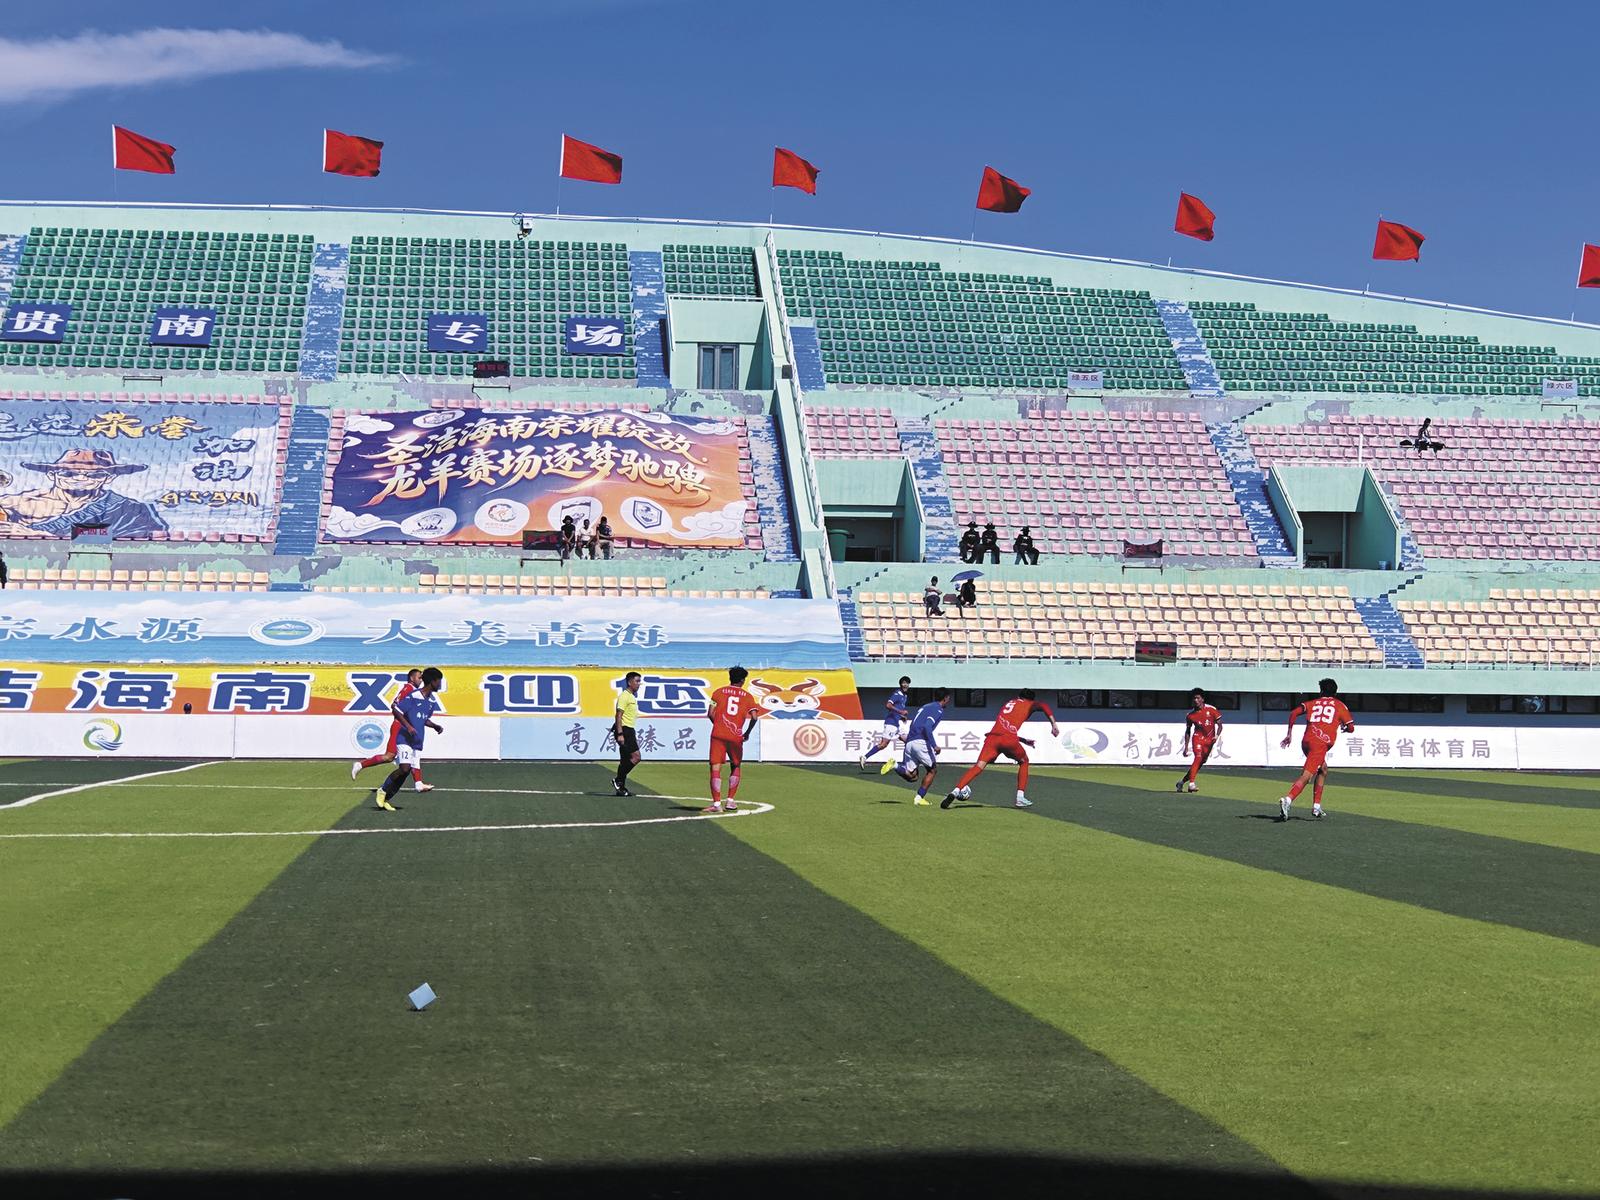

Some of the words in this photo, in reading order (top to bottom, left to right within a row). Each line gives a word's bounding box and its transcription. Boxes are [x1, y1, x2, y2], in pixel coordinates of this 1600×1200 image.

[8, 310, 64, 335] 贵
[156, 313, 212, 338] 南
[431, 320, 486, 346] 专
[569, 322, 624, 348] 场
[1071, 373, 1099, 382] 绿五区
[1546, 382, 1574, 391] 绿六区
[370, 415, 706, 467] 圣洁海南荣耀绽放
[193, 436, 256, 482] 加油
[362, 439, 711, 506] 龙羊赛场逐梦驰骋
[362, 618, 669, 649] 大美青海
[726, 696, 740, 716] 6
[1309, 705, 1336, 724] 29
[564, 722, 697, 753] 高原臻品
[843, 730, 981, 752] 青海省工会
[1345, 736, 1492, 759] 青海省体育局
[400, 751, 409, 760] 12
